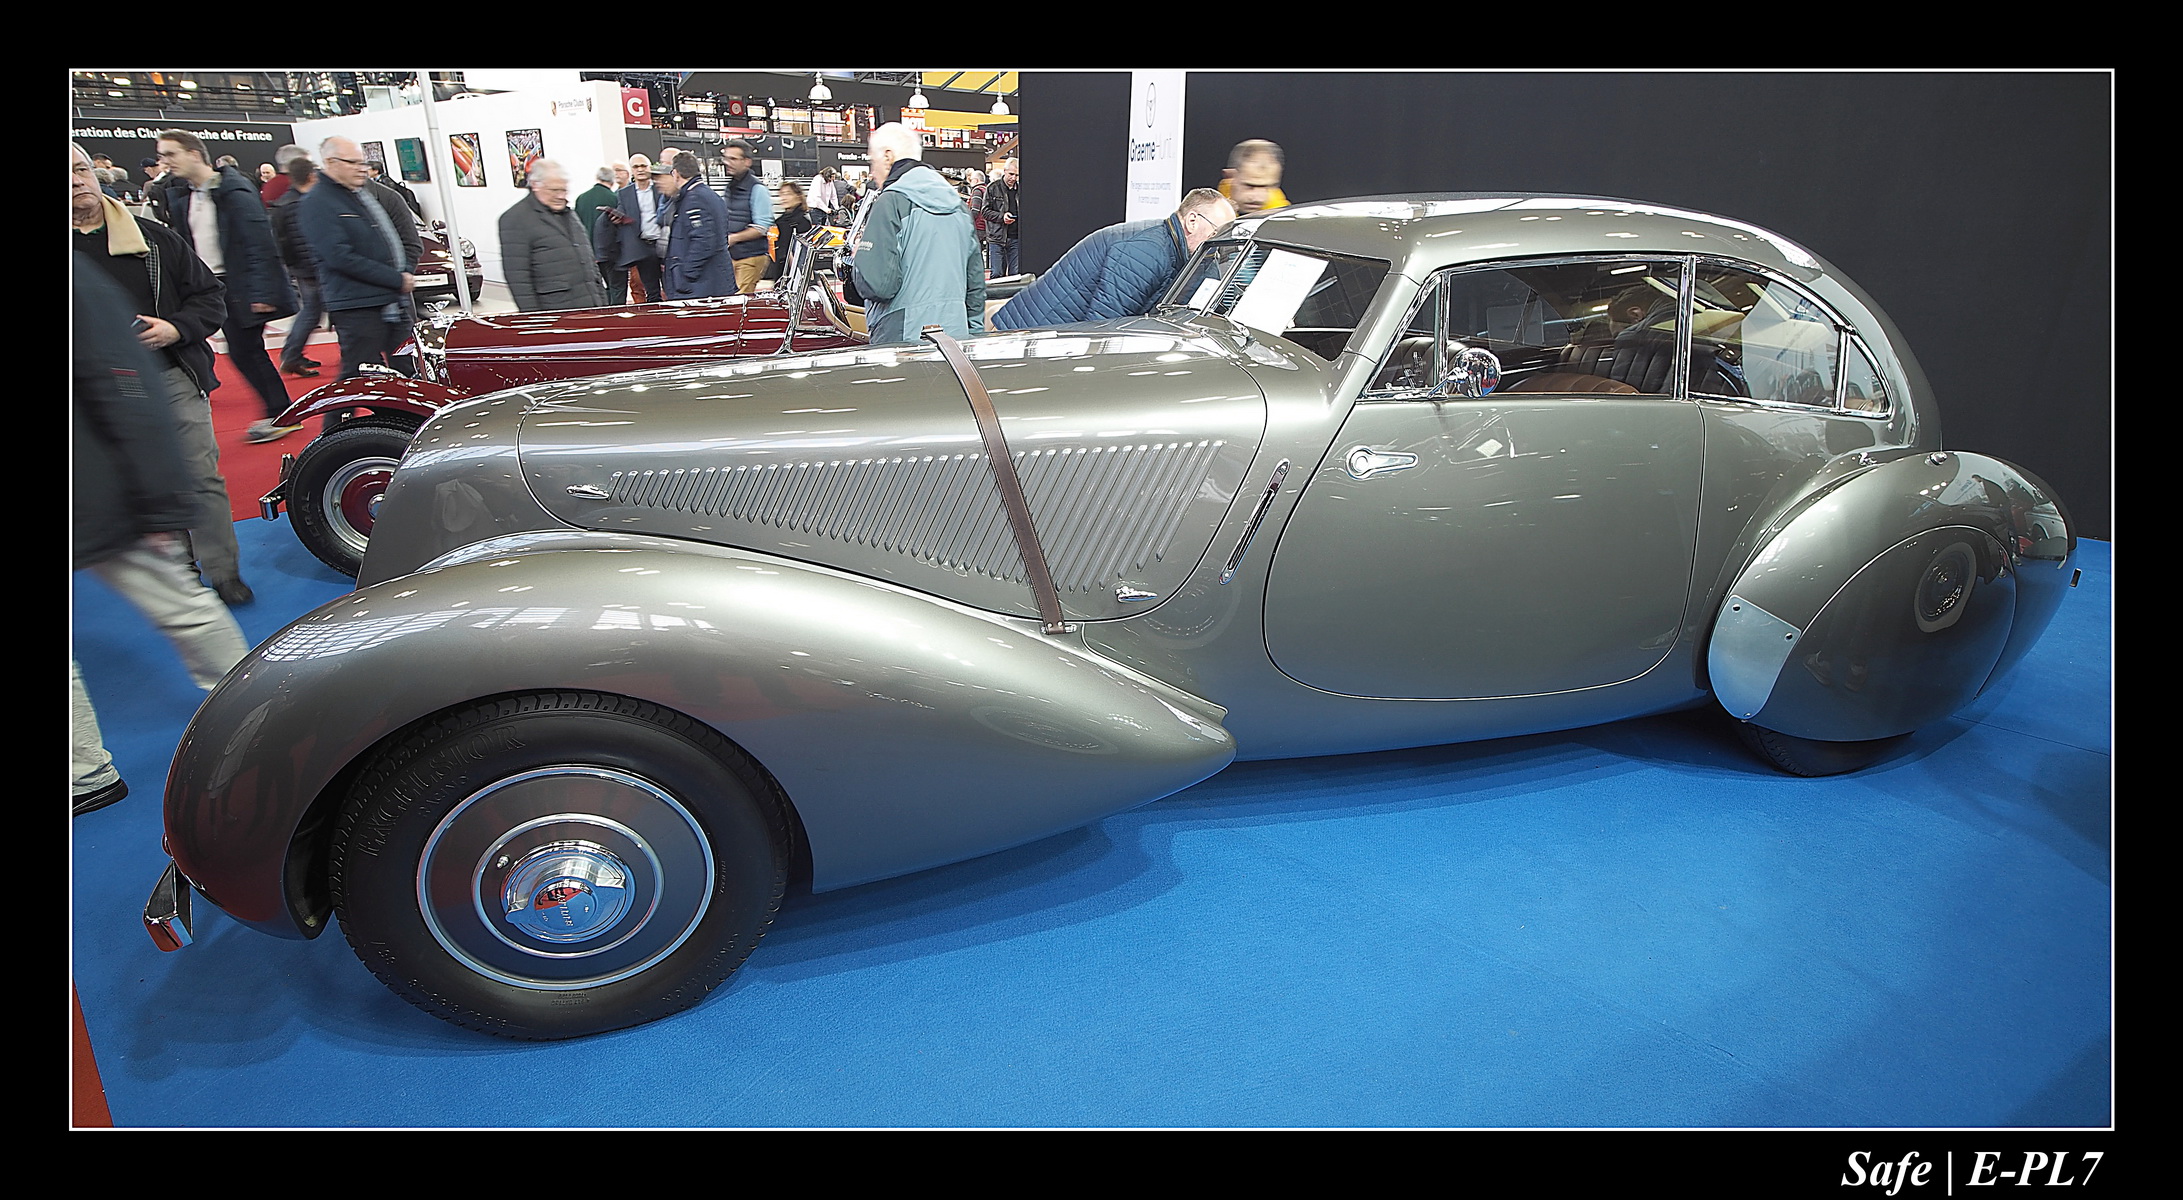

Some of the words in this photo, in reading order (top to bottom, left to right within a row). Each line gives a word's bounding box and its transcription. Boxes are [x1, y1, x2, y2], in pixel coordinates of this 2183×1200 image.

[627, 97, 645, 117] G
[113, 126, 136, 138] des
[220, 129, 235, 141] de
[235, 130, 273, 141] France
[355, 725, 527, 858] EXCELSIOR
